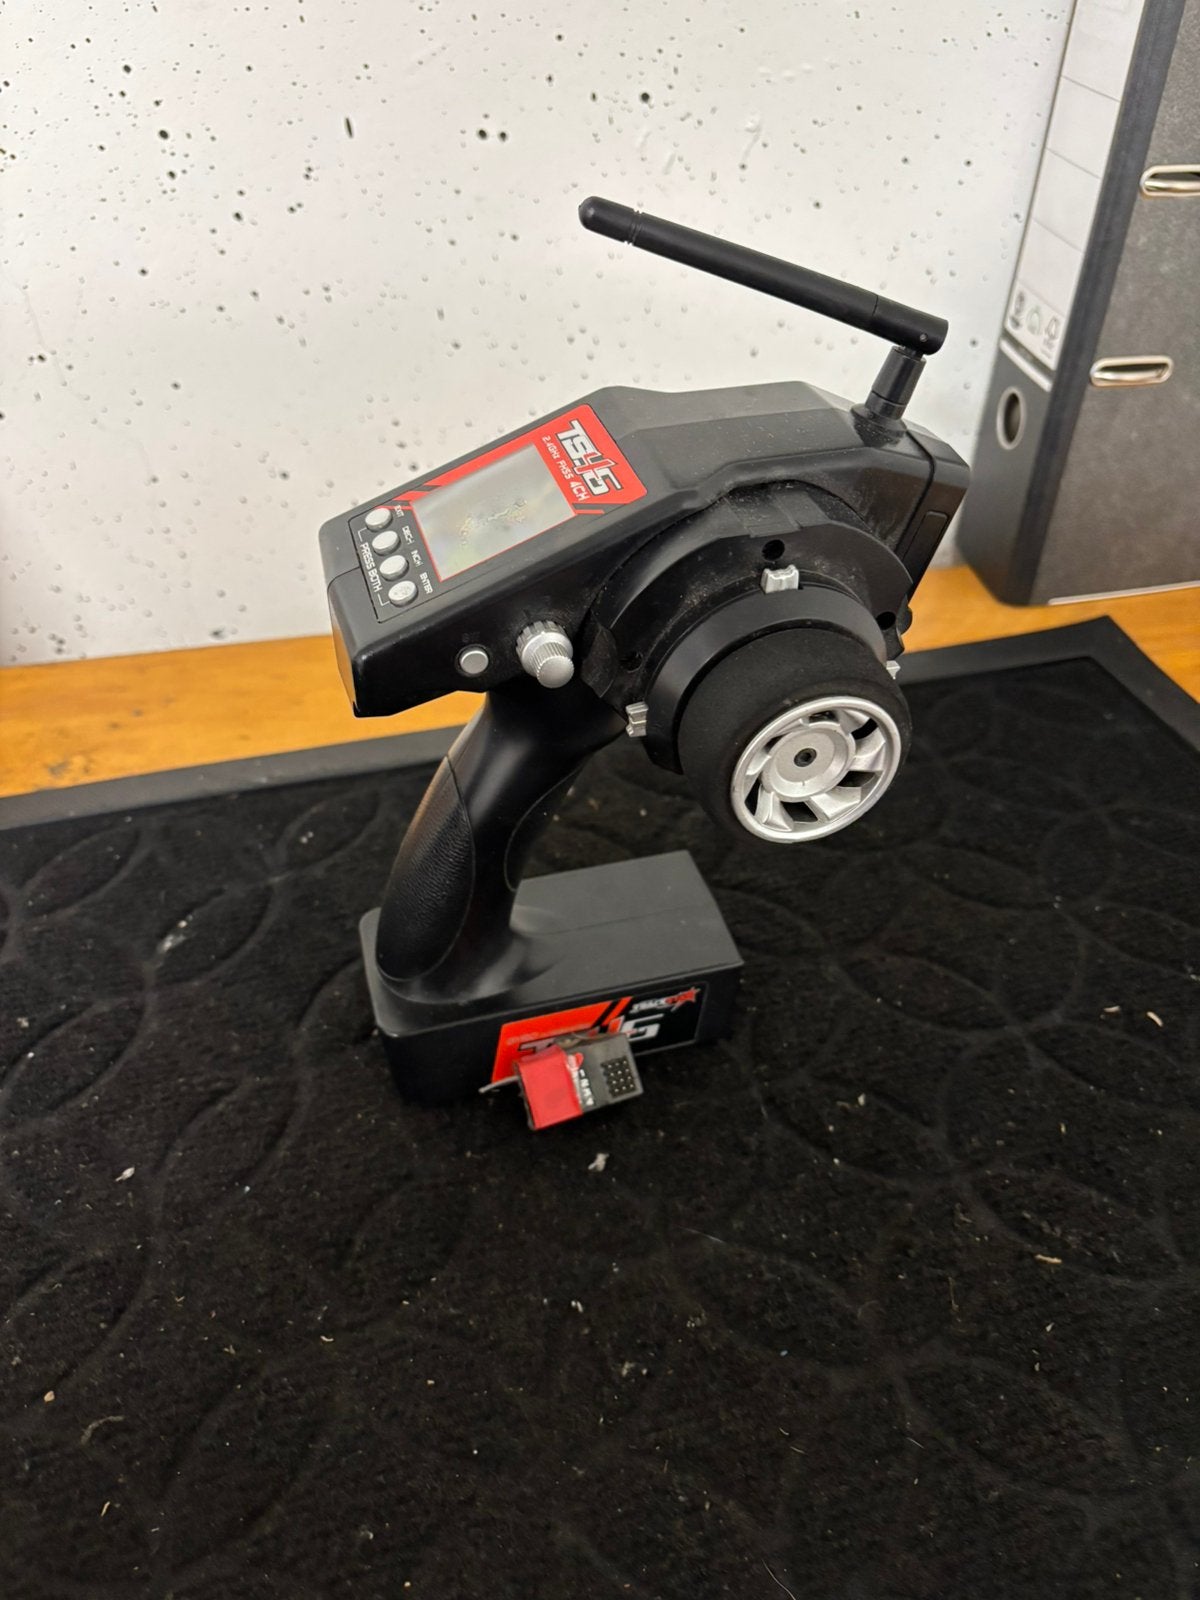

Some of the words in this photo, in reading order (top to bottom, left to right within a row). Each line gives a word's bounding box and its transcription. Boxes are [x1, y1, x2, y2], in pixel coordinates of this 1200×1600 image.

[557, 459, 574, 479] FHSS
[569, 481, 590, 501] 4CH
[360, 542, 375, 570] PRESS
[368, 568, 383, 593] BOTH
[420, 571, 433, 594] ENTER
